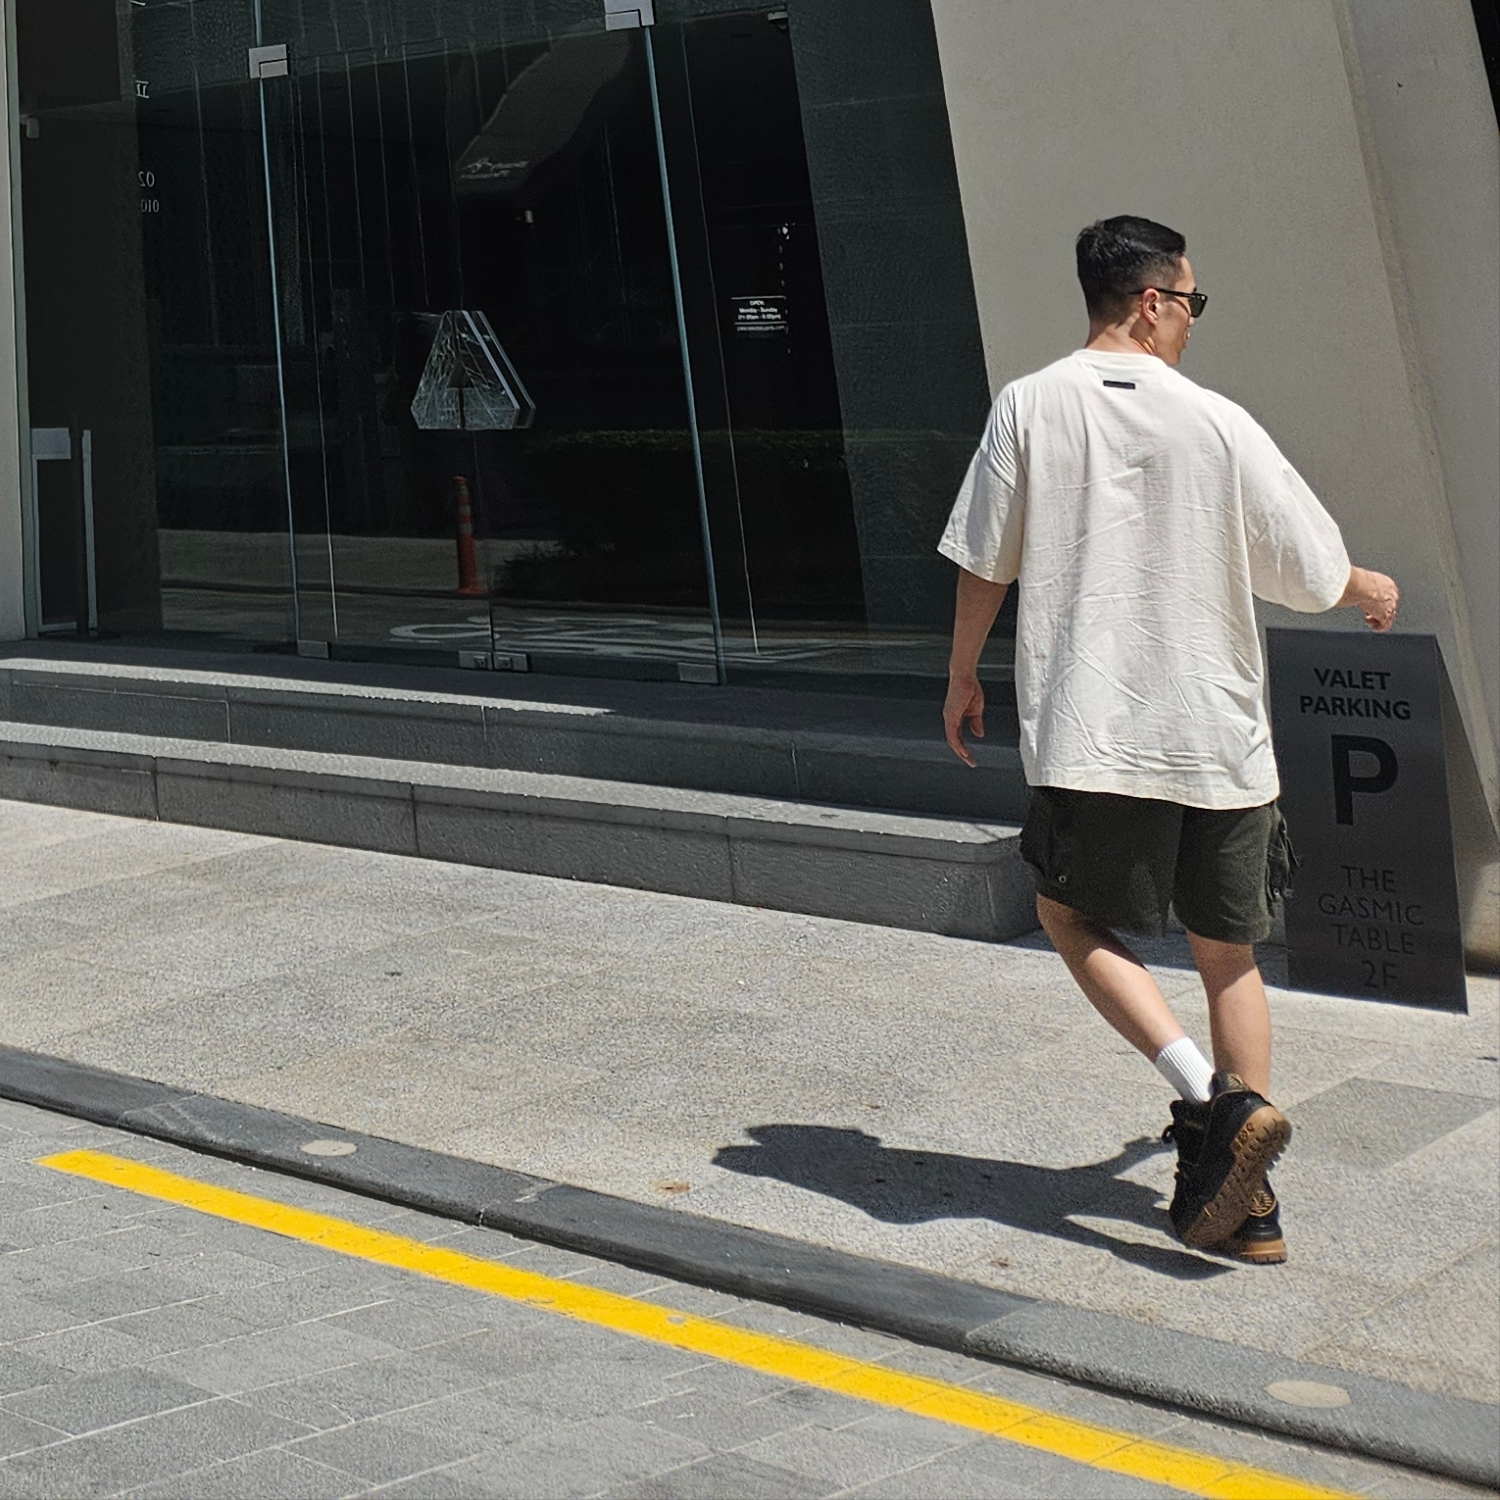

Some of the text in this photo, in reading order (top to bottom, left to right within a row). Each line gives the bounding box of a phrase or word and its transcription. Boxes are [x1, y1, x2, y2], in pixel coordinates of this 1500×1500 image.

[1313, 668, 1391, 691] VALET
[1299, 695, 1412, 721] PARKING
[1330, 733, 1399, 826] P
[1341, 865, 1396, 893] THE
[1318, 893, 1425, 926] GASMIC
[1331, 923, 1416, 956] TABLE
[1361, 959, 1398, 989] 2F
